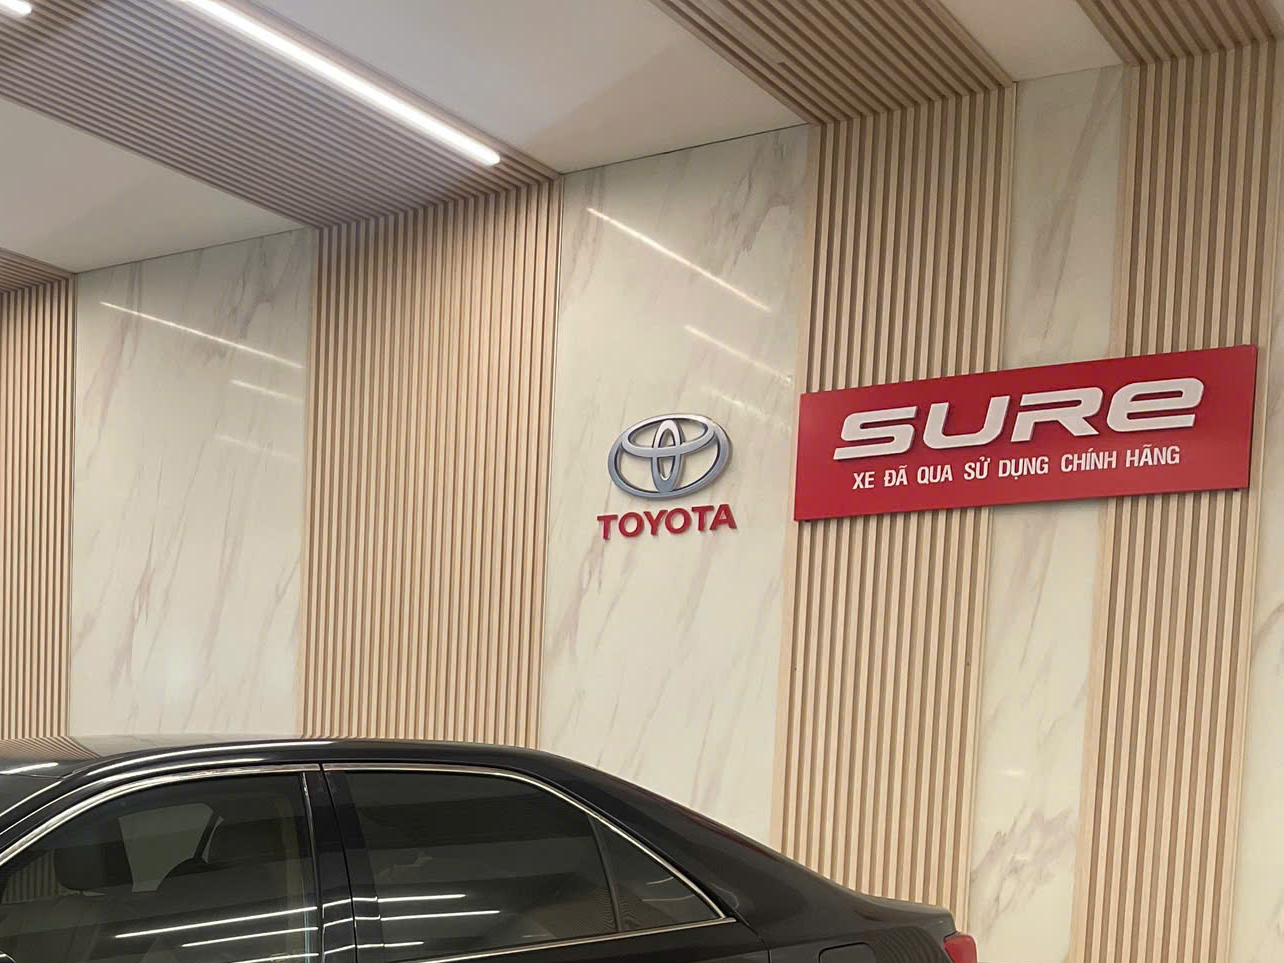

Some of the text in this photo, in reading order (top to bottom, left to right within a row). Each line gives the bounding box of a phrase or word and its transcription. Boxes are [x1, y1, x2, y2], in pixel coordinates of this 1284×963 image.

[852, 444, 1181, 490] XE ĐÃ QUA SỬ DỤNG CHÍNH HÃNG
[597, 504, 737, 540] TOYOTA
